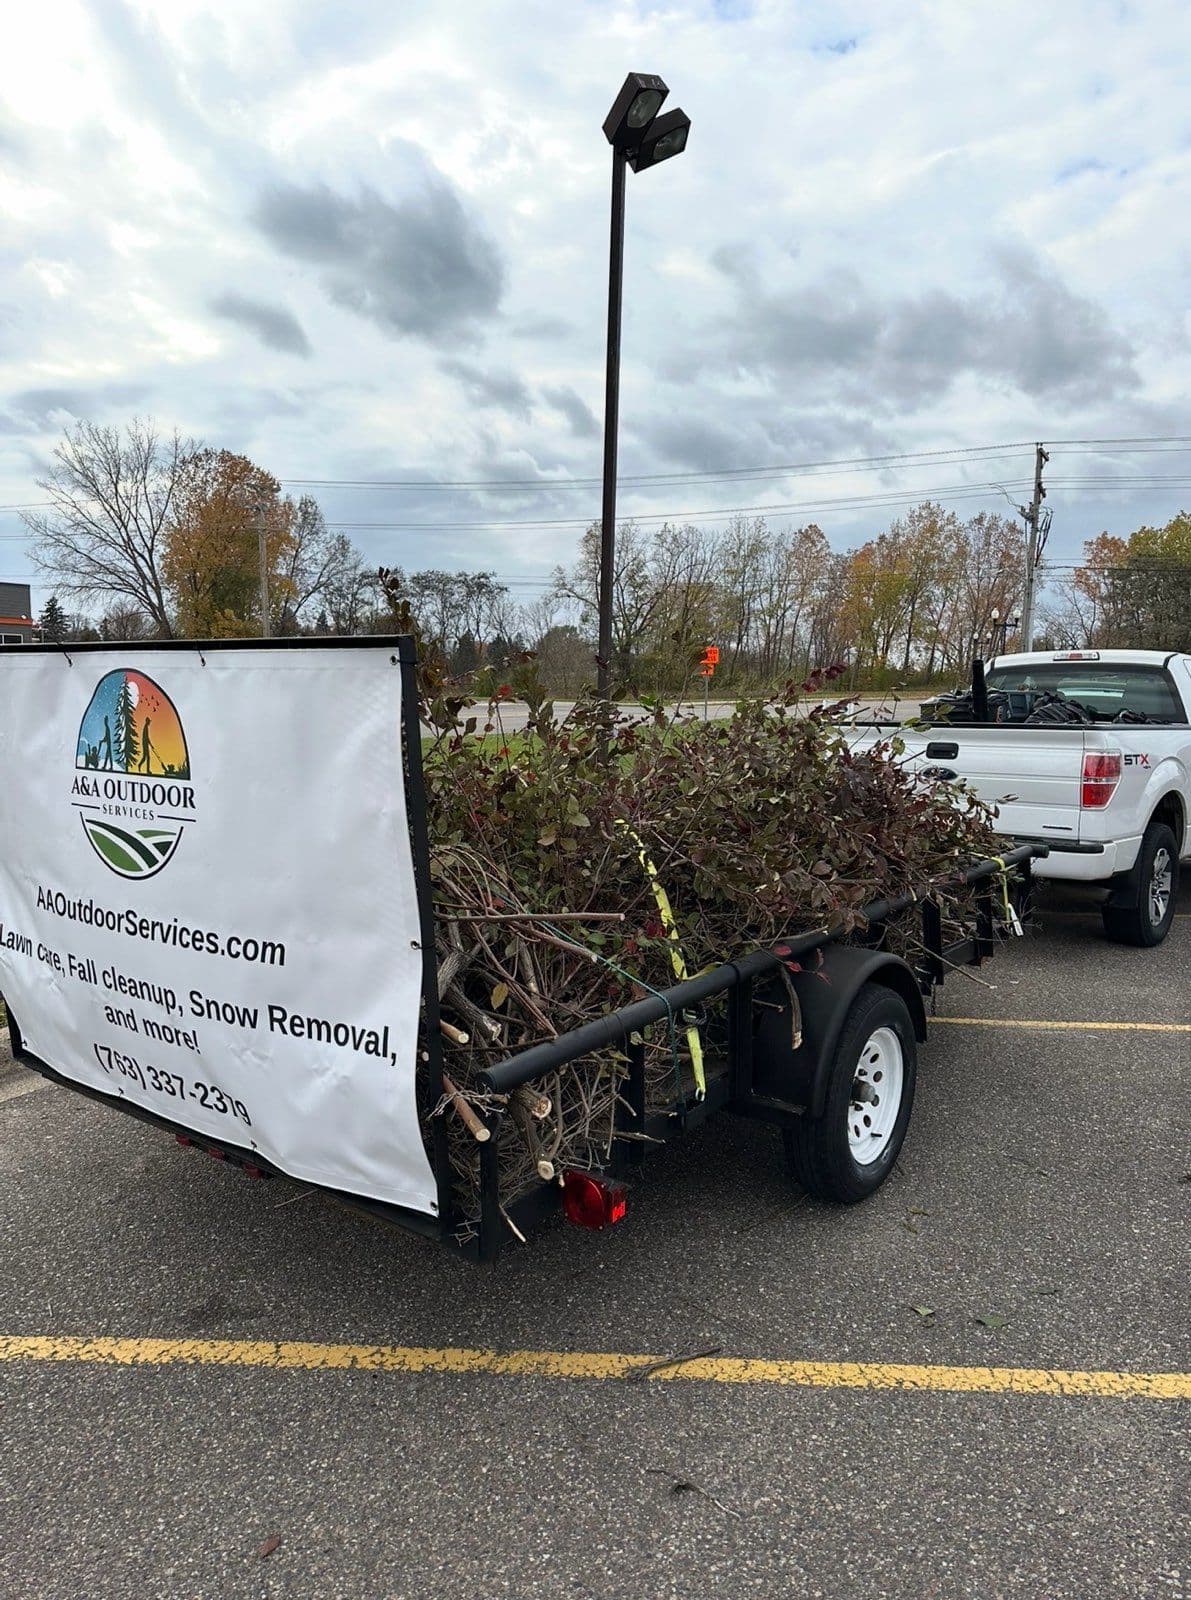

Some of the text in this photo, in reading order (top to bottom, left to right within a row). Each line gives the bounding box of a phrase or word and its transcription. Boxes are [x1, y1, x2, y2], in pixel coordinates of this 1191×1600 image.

[1124, 753, 1149, 765] STX
[71, 776, 196, 809] A&A OUTDOOR
[102, 804, 154, 821] SERVICES
[37, 886, 286, 966] AAOutdoorServices.com
[0, 923, 397, 1066] Lawn care, Fall cleanup, Snow Removal,
[104, 1005, 200, 1054] and more!
[94, 1043, 251, 1126] (763) 337-2379
